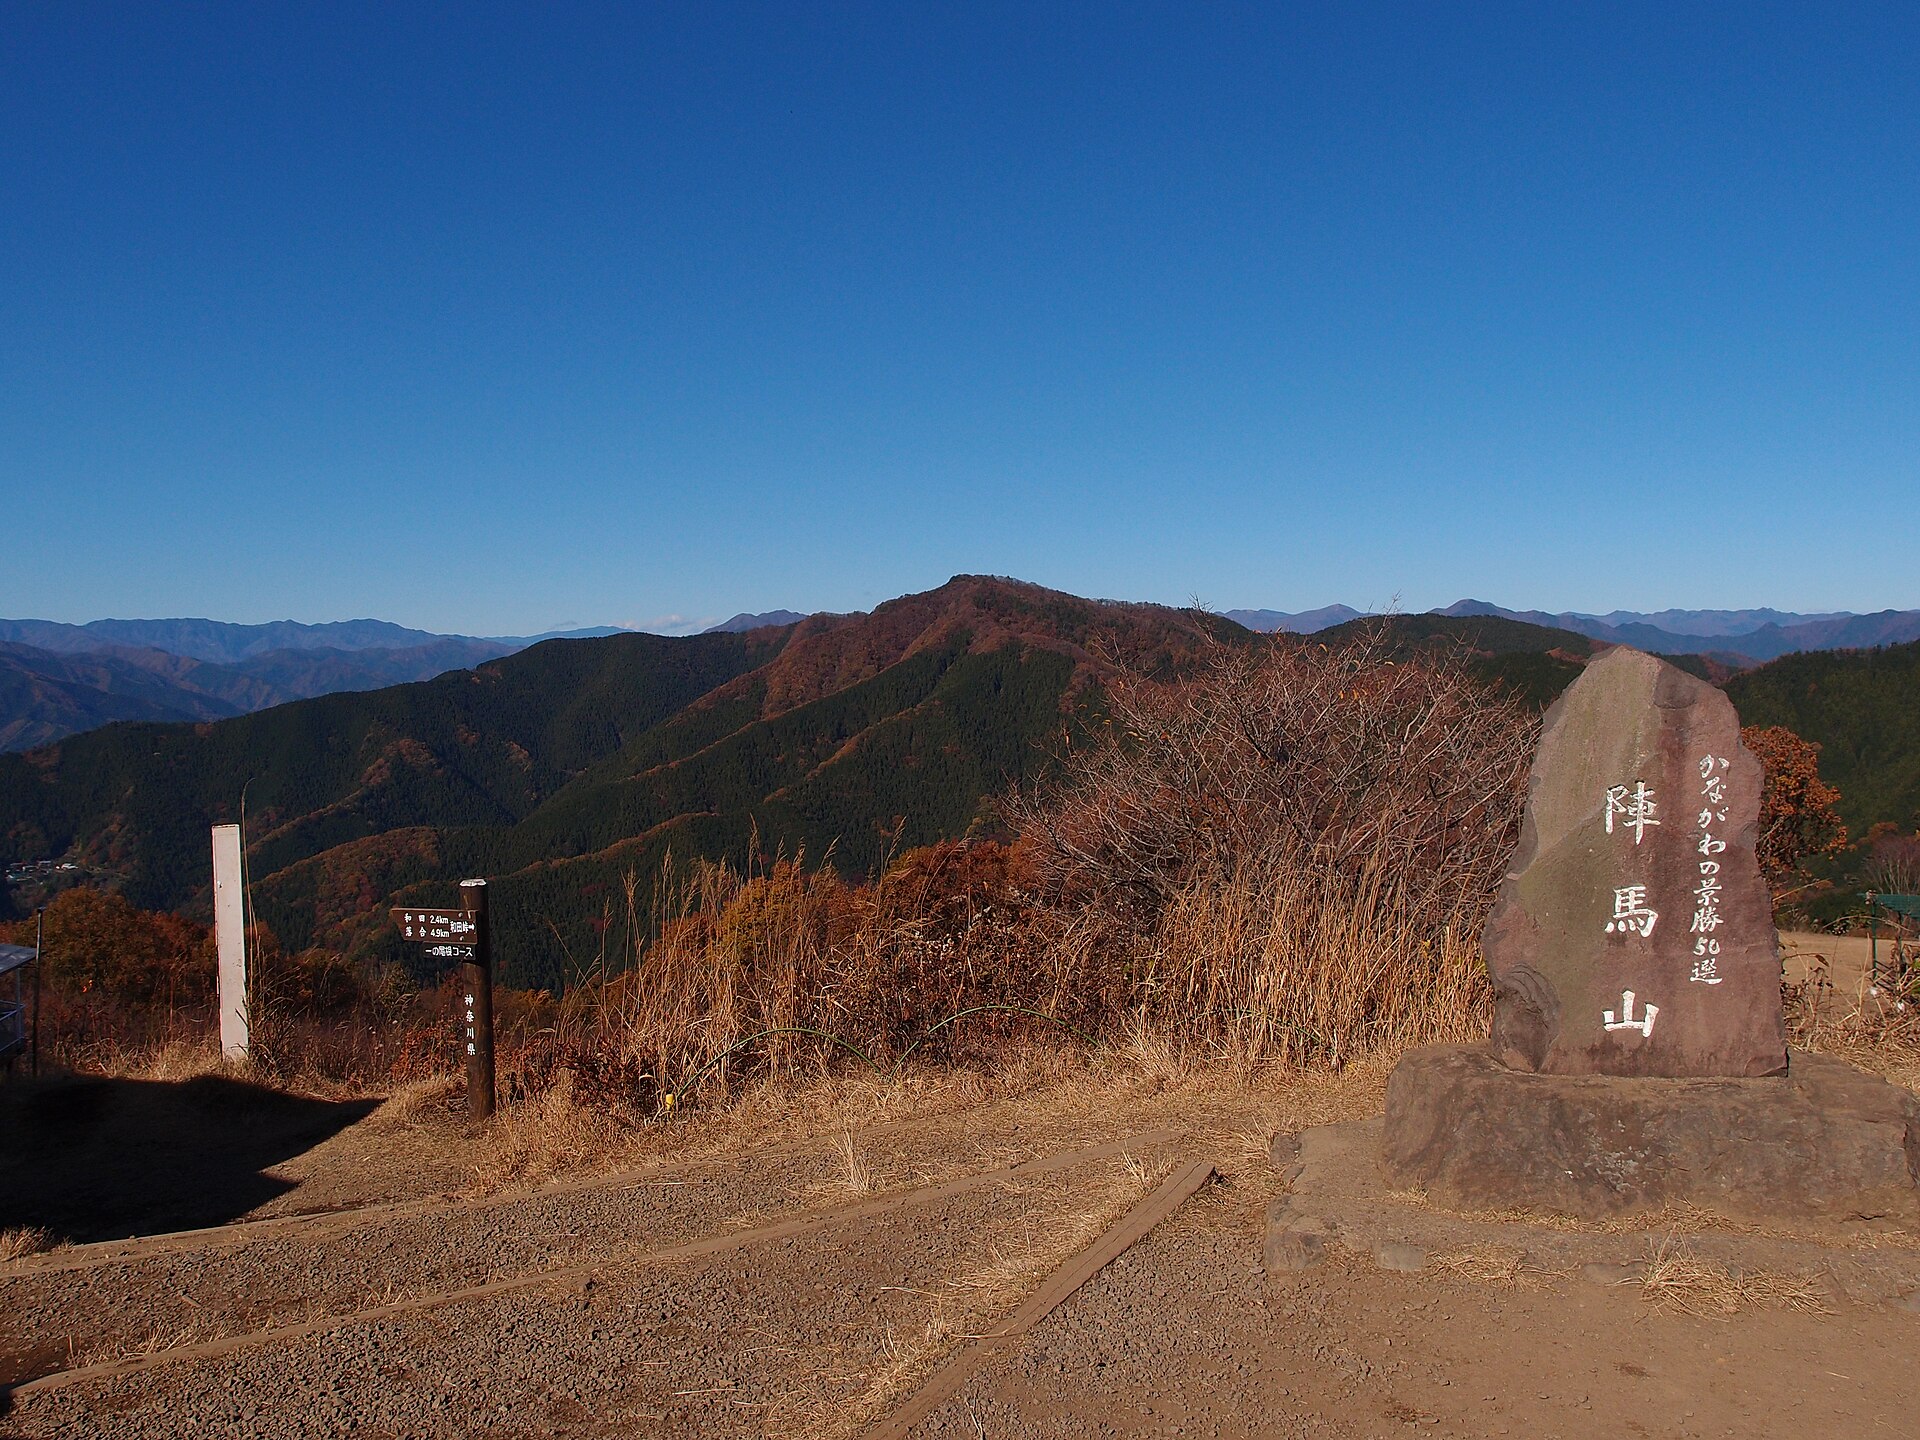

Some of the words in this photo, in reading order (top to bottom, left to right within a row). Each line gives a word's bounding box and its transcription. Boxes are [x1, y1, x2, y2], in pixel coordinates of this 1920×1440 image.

[1690, 754, 1730, 985] かながわの景勝50選
[430, 915, 449, 924] 2.4km
[430, 928, 450, 938] 4.9km
[1603, 780, 1661, 1038] 陣馬山
[464, 994, 476, 1056] 神奈川県
